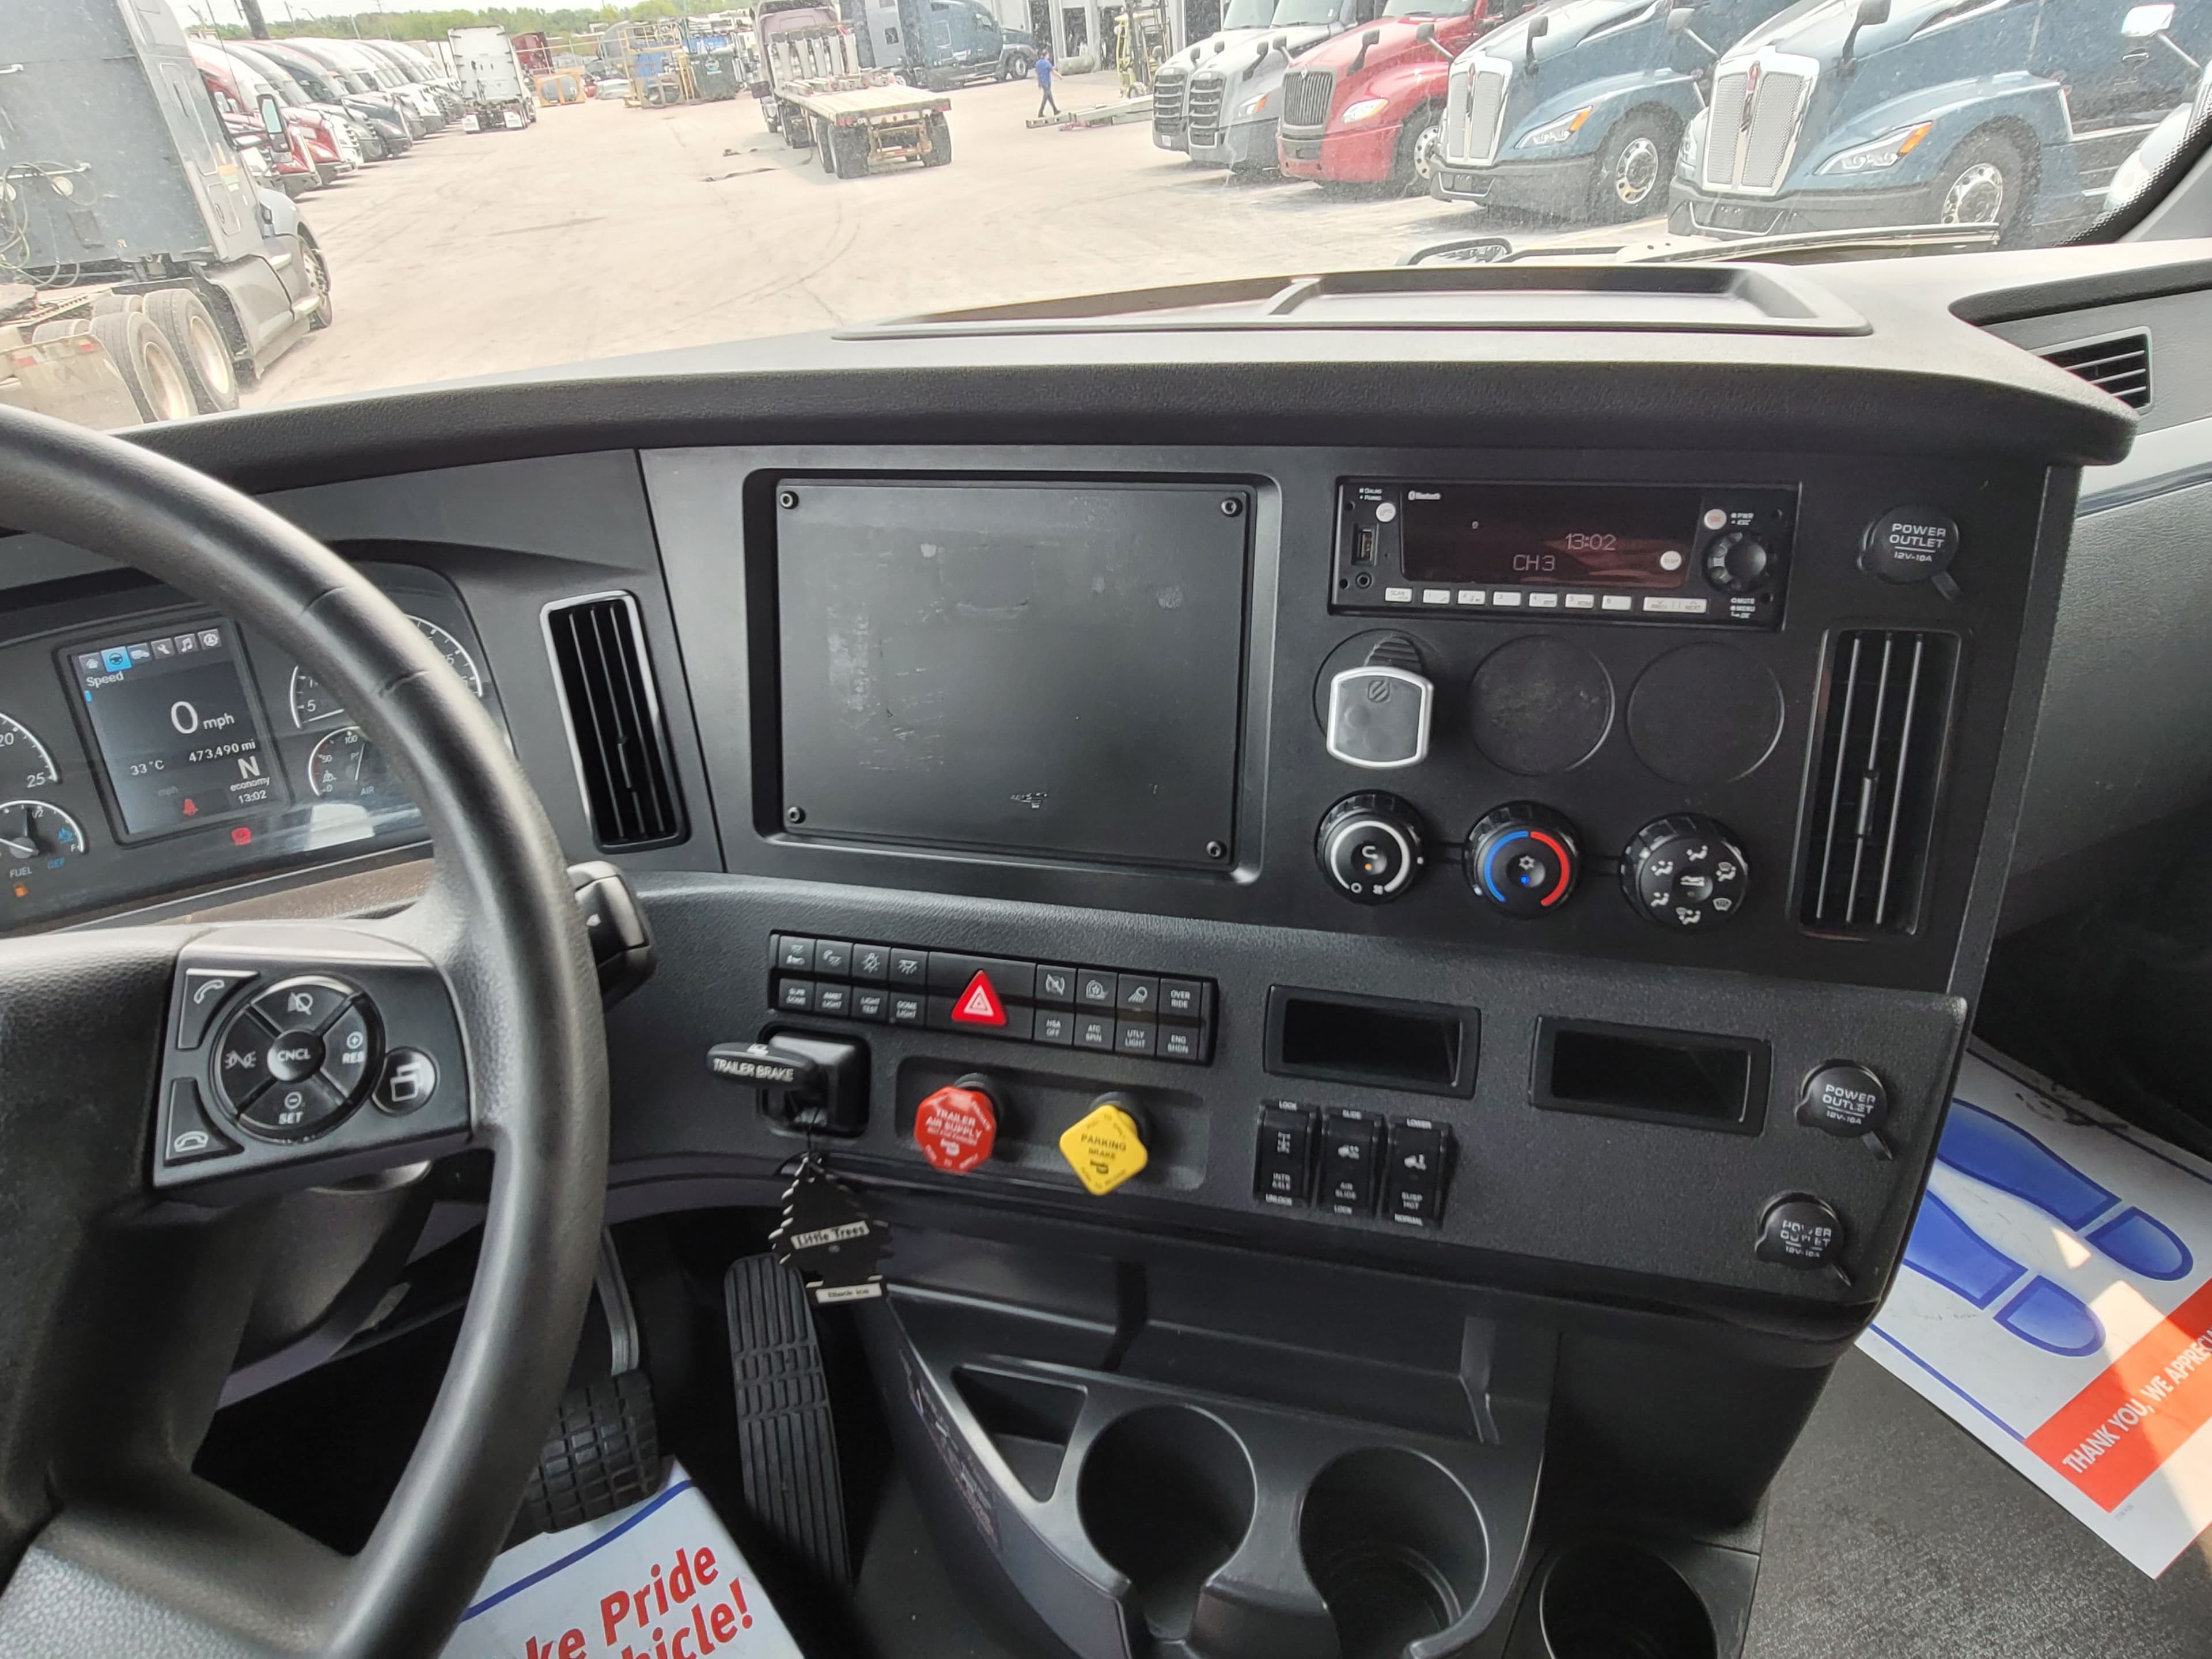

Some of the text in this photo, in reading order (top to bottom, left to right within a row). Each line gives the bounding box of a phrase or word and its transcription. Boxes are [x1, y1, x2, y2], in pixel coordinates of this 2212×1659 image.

[1892, 523, 1946, 537] POWER
[1565, 533, 1616, 551] 13:02
[1889, 535, 1945, 548] OUTLET
[86, 671, 124, 688] Speed
[307, 699, 316, 712] 5
[171, 701, 235, 733] 0 mph
[0, 732, 14, 747] 20
[345, 735, 358, 744] 100
[189, 739, 255, 762] 473,490 mi
[322, 755, 332, 763] 50
[238, 756, 260, 779] N
[27, 772, 46, 788] 25
[230, 777, 270, 791] economy
[238, 790, 267, 804] 13:02
[360, 786, 374, 796] AIR
[9, 866, 33, 878] FUEL
[1171, 990, 1191, 1000] OVER
[1171, 999, 1188, 1009] RIDE
[1124, 1039, 1146, 1048] LIGHT
[1171, 1035, 1187, 1044] ENG
[277, 1048, 310, 1061] CNCL
[342, 1052, 365, 1063] RES
[713, 1058, 794, 1082] TRAILER BRAKE
[1825, 1084, 1876, 1104] POWER
[1279, 1100, 1297, 1111] LOCK
[1823, 1094, 1874, 1114] OUTLET
[279, 1112, 303, 1124] SET
[936, 1107, 976, 1127] TRAILER
[926, 1116, 982, 1139] AIR SUPPLY
[1081, 1133, 1126, 1152] PARKING
[1088, 1147, 1116, 1160] BRAKE
[1266, 1194, 1293, 1206] UNLOCK
[1334, 1205, 1352, 1215] LOCK
[831, 1225, 864, 1240] Trees
[2062, 1326, 2212, 1474] THANK YOU, WE APPRECI
[600, 1547, 719, 1646] Pride
[620, 1577, 753, 1659] icle!
